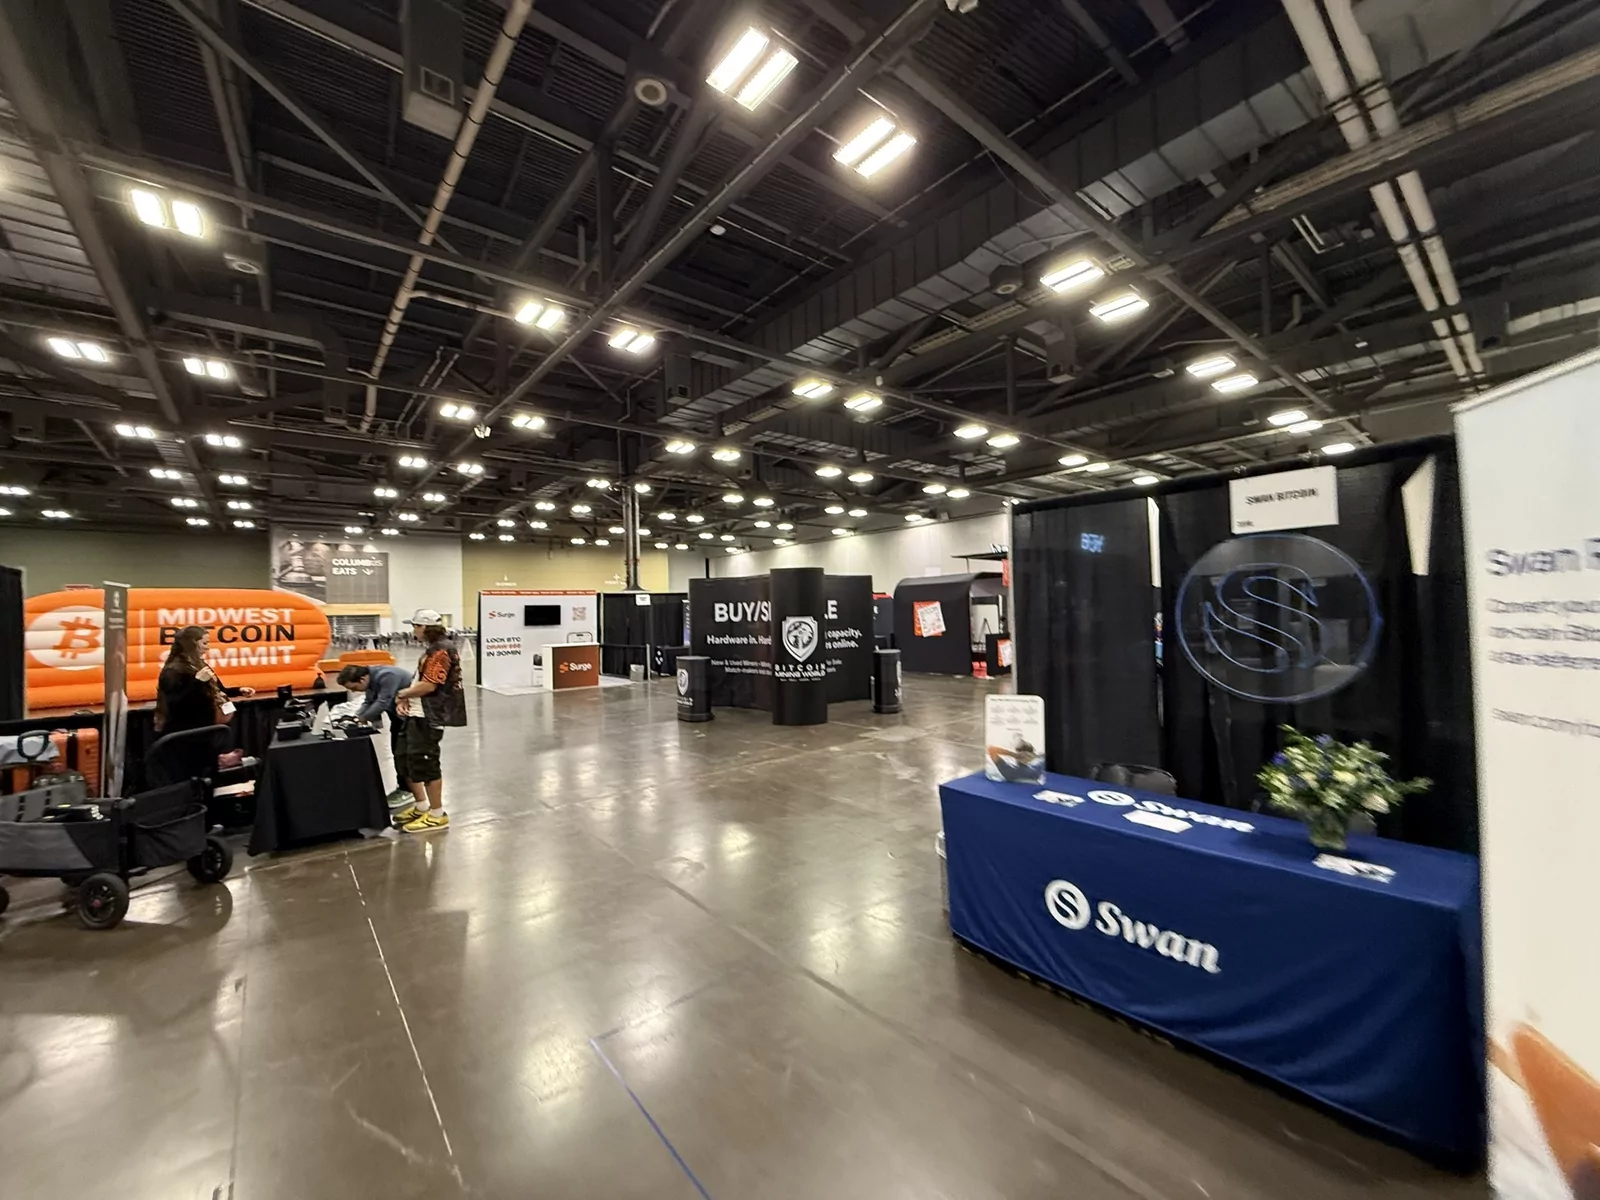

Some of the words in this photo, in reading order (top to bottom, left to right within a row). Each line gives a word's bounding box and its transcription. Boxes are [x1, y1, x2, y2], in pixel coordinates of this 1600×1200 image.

[332, 567, 357, 575] EATS
[157, 608, 295, 625] MIDWEST
[706, 634, 748, 645] Hardware
[828, 628, 862, 640] capacity.
[833, 639, 858, 649] online.
[569, 663, 592, 671] Surge
[1133, 800, 1255, 832] Swan
[1095, 901, 1222, 974] Swan
